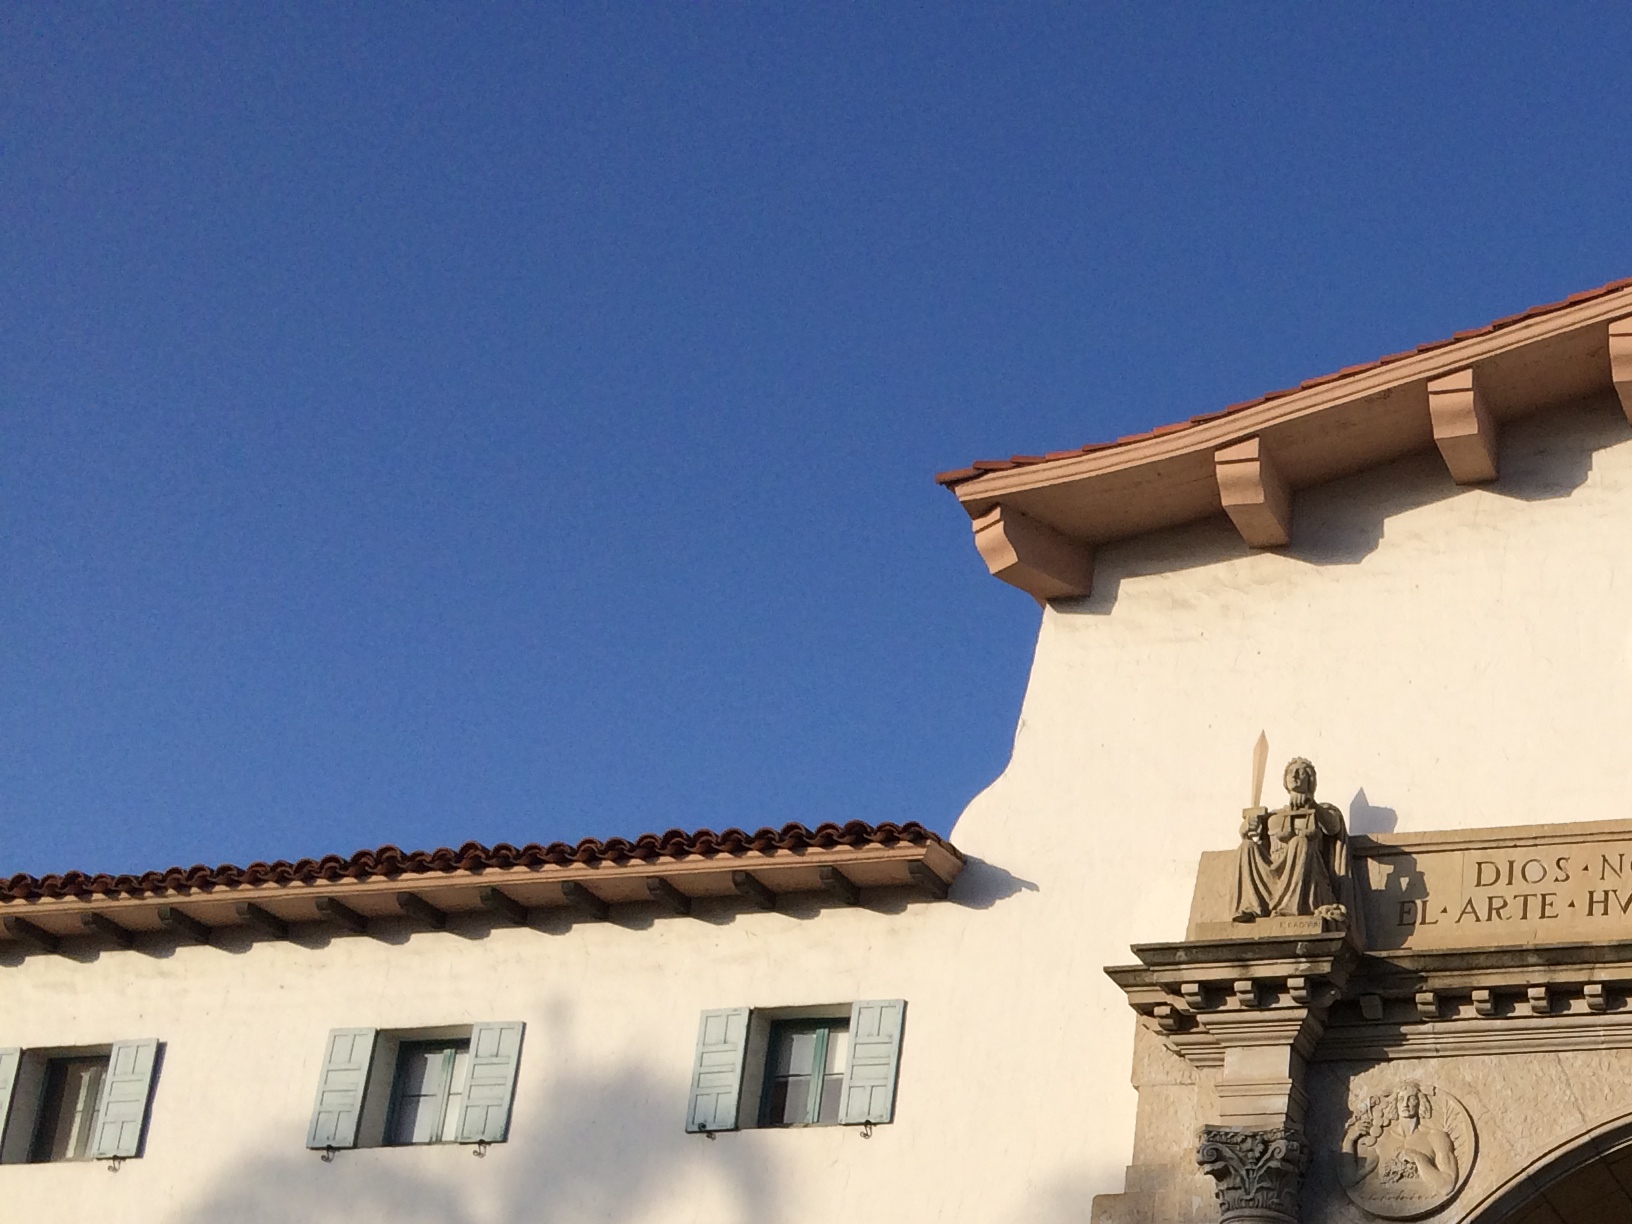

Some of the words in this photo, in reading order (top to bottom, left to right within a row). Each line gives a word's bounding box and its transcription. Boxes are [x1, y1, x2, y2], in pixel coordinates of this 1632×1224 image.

[1473, 856, 1572, 888] DIOS
[1397, 900, 1440, 927] EL
[1454, 892, 1560, 924] ARTE
